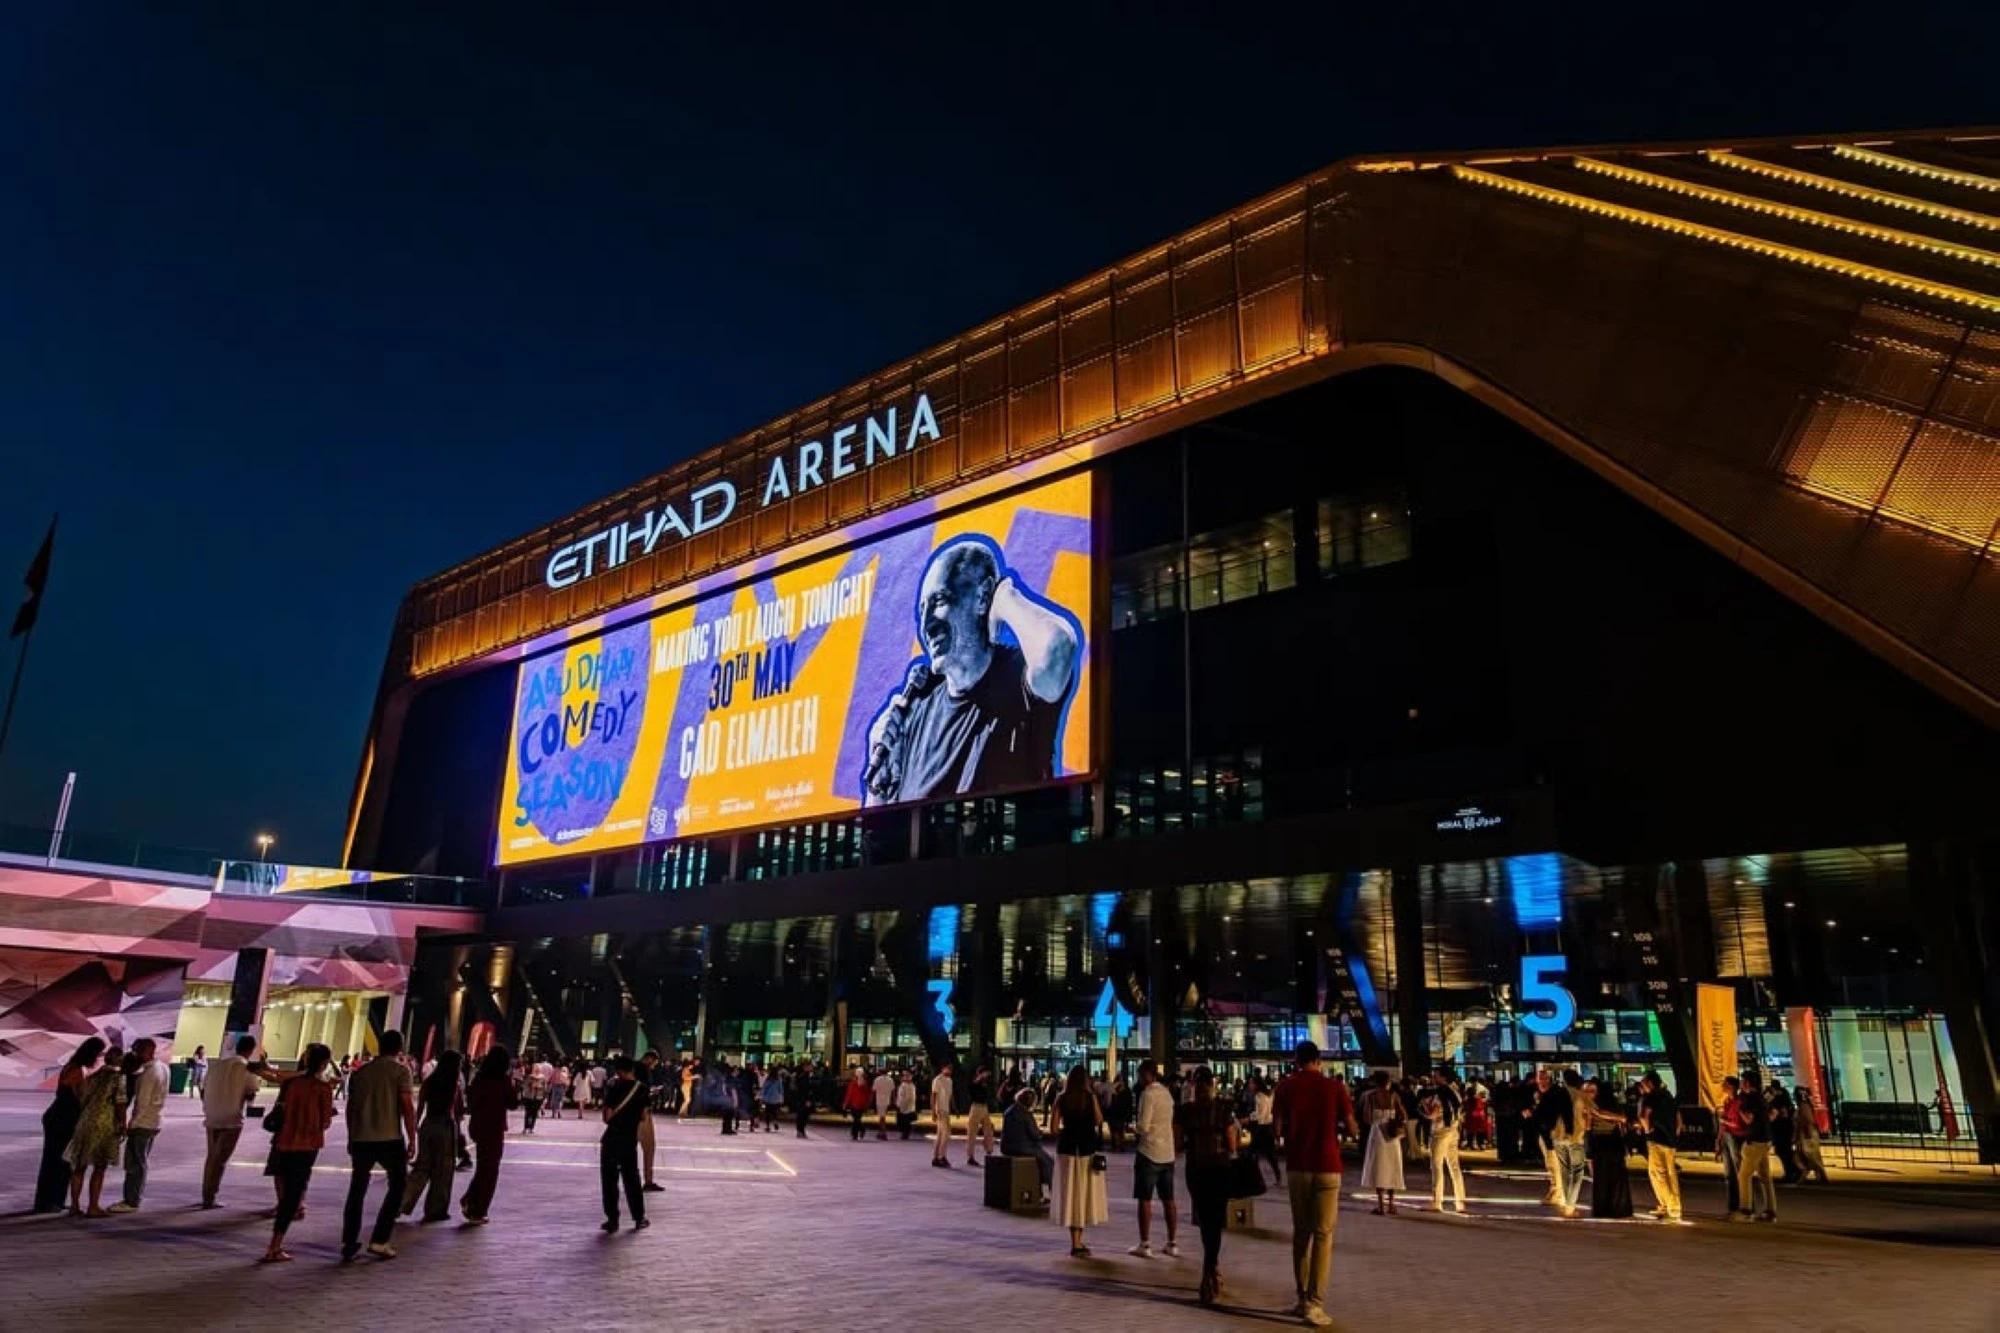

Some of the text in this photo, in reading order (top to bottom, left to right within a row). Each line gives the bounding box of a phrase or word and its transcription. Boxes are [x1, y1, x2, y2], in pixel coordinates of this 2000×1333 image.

[546, 394, 941, 588] ETIHAD ARENA
[654, 570, 873, 674] MAKING YOU LAUGH TONIGHT
[524, 666, 571, 718] ABU
[708, 640, 797, 711] 30TH MAY
[520, 690, 637, 773] COMEDY
[679, 695, 819, 779] GAD ELMALEH
[514, 754, 624, 826] SEASON
[927, 979, 955, 1035] 3
[1094, 976, 1134, 1038] 4
[1519, 955, 1577, 1035] 5
